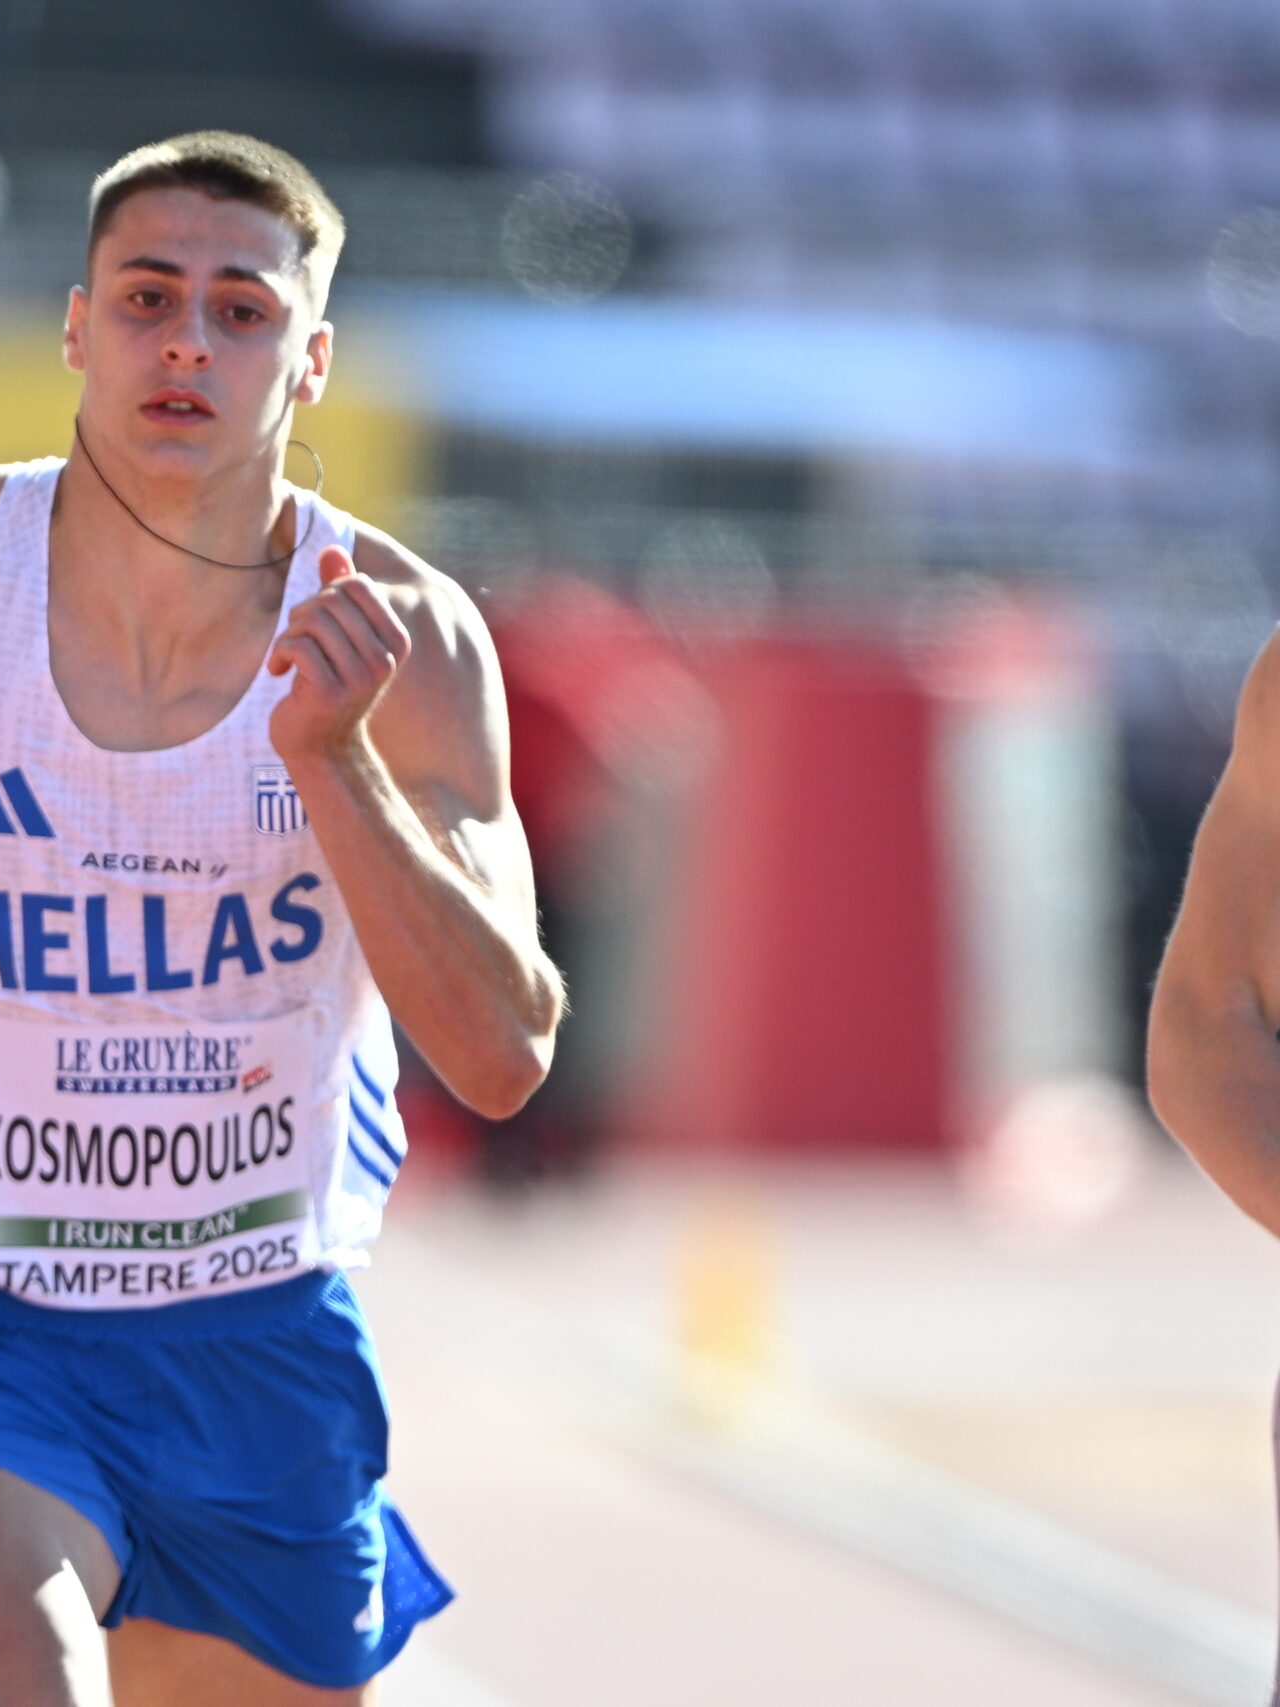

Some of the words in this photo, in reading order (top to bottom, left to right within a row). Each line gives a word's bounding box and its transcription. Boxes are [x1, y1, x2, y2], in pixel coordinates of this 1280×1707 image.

[81, 851, 200, 873] AEGEAN
[56, 1037, 92, 1073] LE
[63, 1076, 232, 1093] SWITZERLAND
[48, 1220, 58, 1245] I
[64, 1220, 134, 1248] RUN
[208, 1235, 299, 1285] 2025
